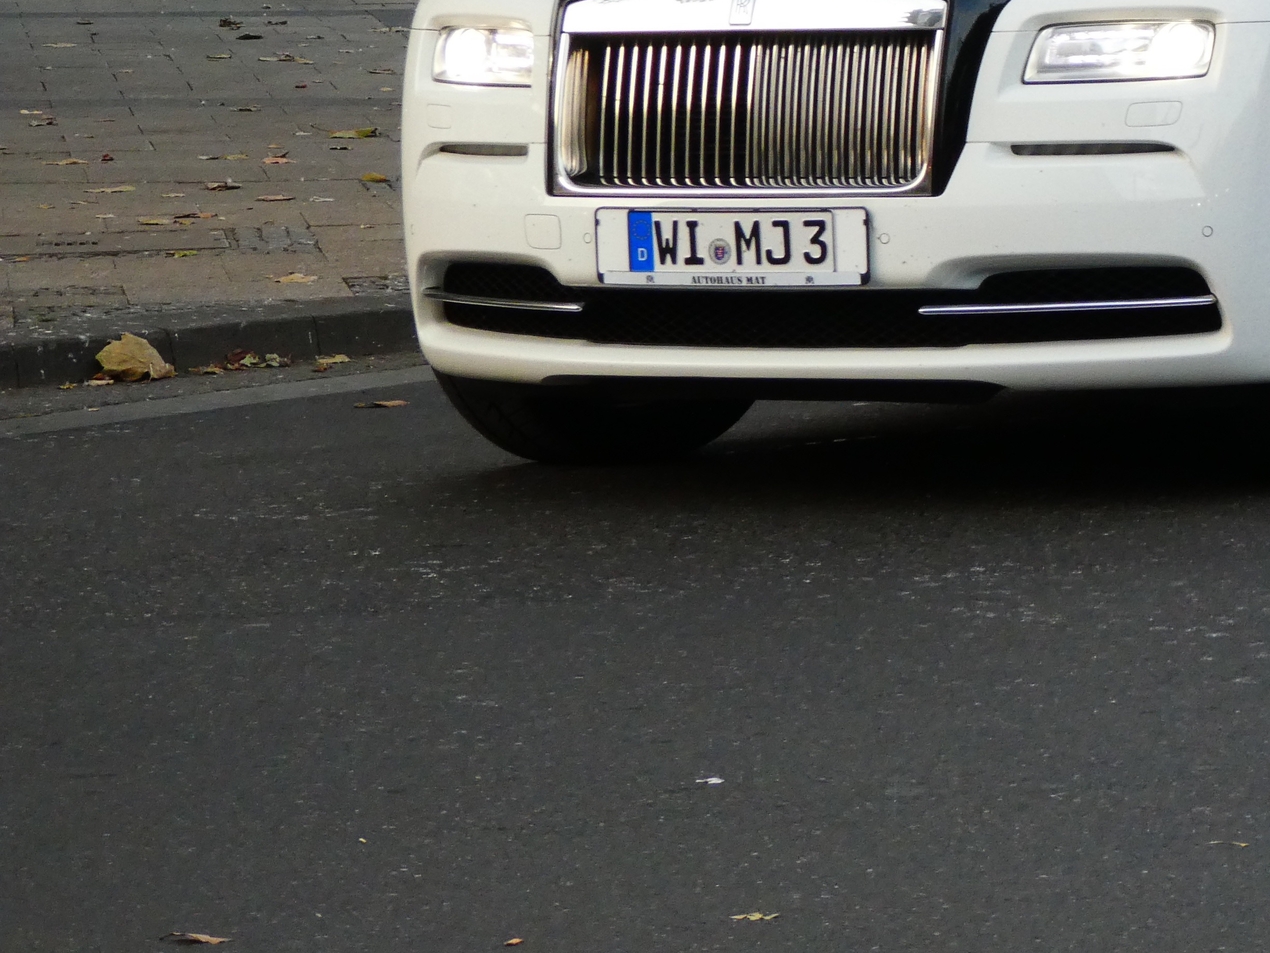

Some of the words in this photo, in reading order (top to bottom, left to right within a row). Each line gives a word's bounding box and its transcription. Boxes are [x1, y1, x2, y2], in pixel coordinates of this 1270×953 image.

[637, 247, 648, 261] D
[691, 275, 743, 285] AUTOHAUS
[745, 275, 767, 285] MAT
